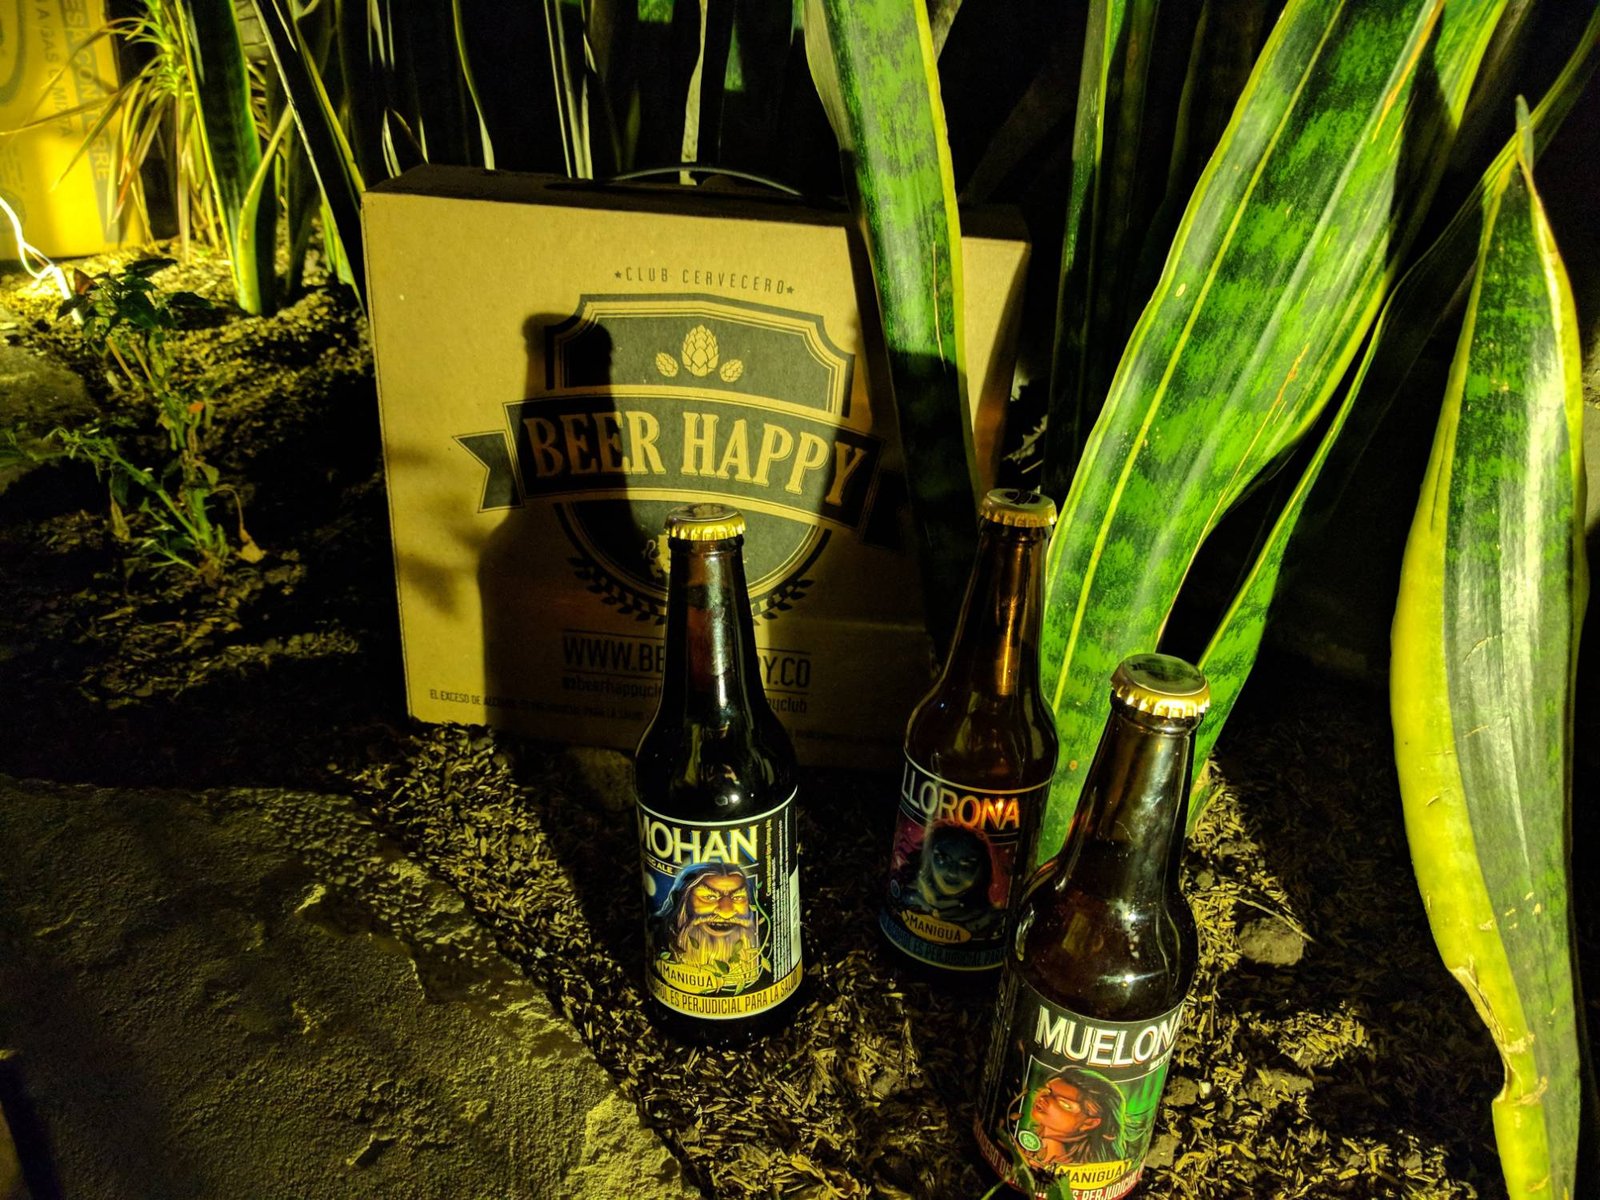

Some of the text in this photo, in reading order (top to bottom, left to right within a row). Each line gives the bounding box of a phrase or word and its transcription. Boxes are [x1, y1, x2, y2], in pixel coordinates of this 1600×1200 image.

[626, 267, 785, 294] CLUB CERVECERO
[523, 410, 868, 507] BEER HAPPY
[901, 761, 1021, 830] LLORONA
[657, 862, 673, 875] ALE
[910, 914, 962, 941] MANIGUA
[662, 963, 714, 988] MANIGUA
[670, 990, 680, 1007] ES
[682, 995, 742, 1015] PERJUDICIAL
[745, 991, 768, 1010] PARA
[770, 986, 779, 1003] LA
